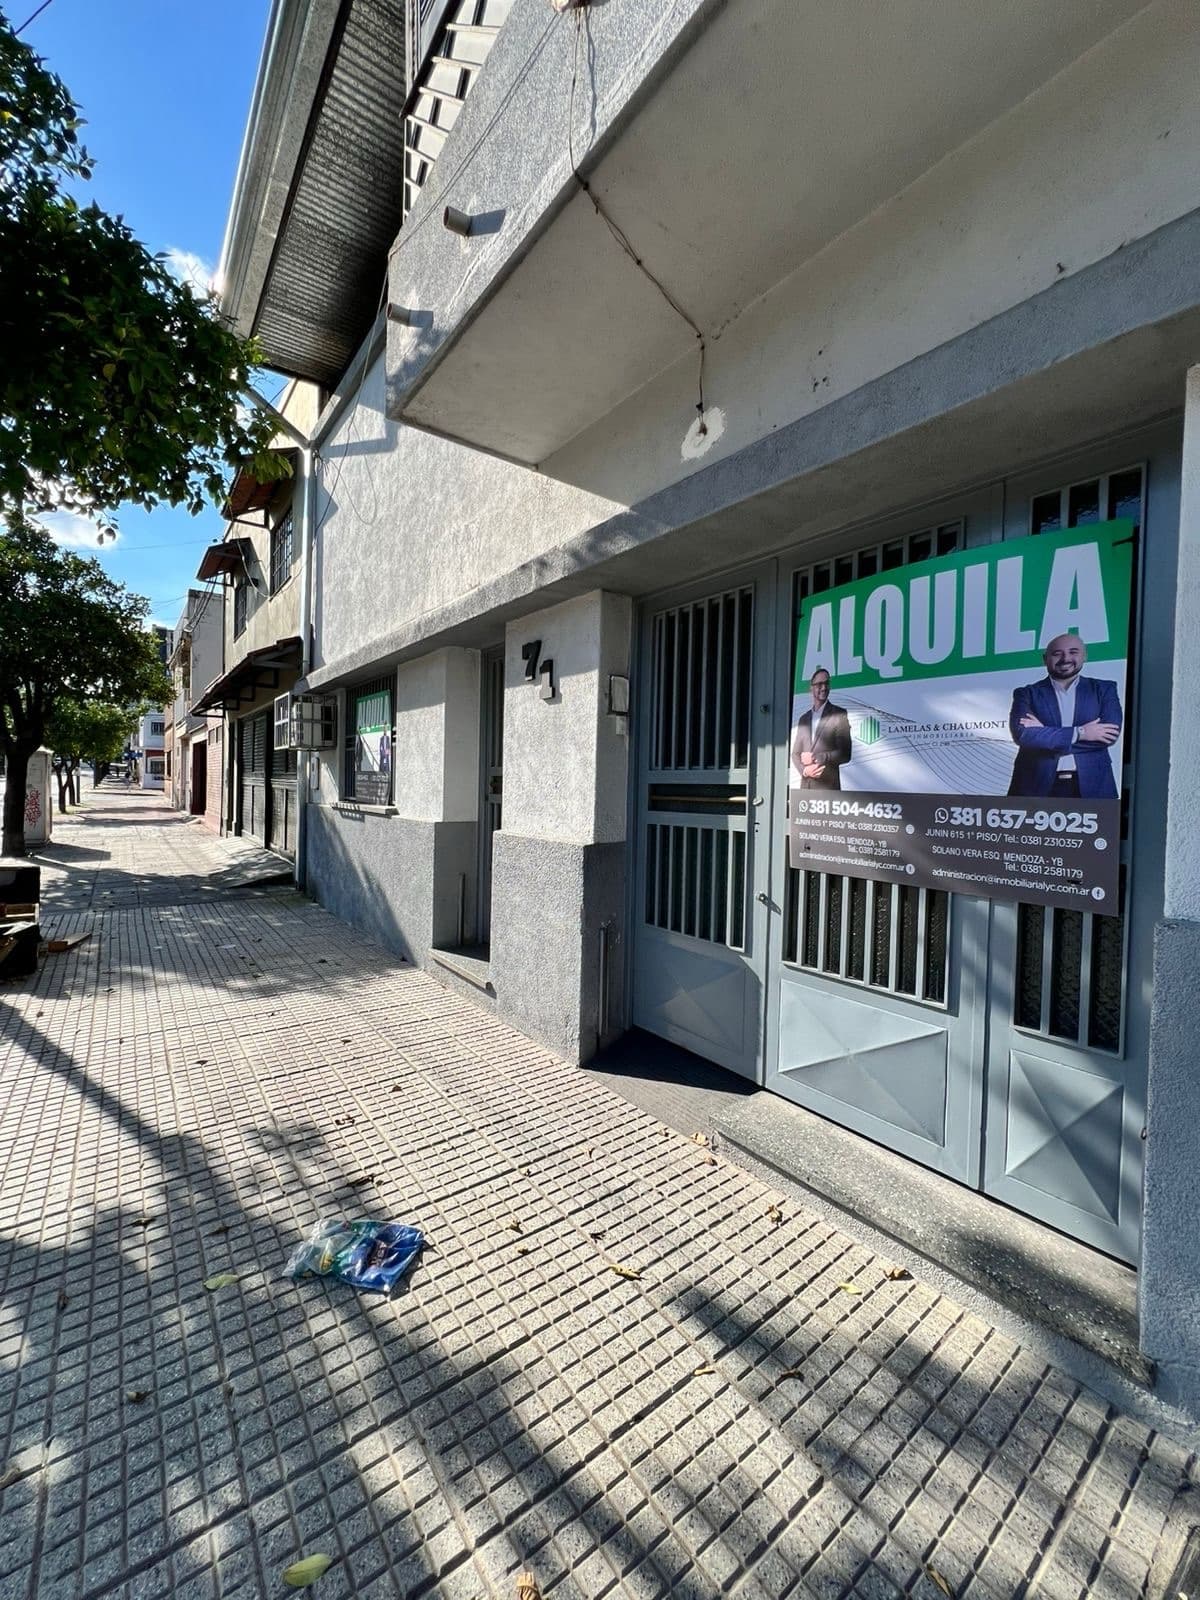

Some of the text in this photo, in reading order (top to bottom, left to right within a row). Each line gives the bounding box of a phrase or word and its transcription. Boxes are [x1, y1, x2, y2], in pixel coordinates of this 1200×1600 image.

[802, 542, 1110, 681] ALQUILA
[888, 720, 1008, 734] LAMELAS & CHAUMONT
[808, 800, 903, 820] 381 504-4632
[950, 807, 1099, 834] 381 637-9025
[950, 830, 965, 840] 615
[1020, 835, 1042, 846] 0381
[1044, 837, 1084, 849] 2310357
[932, 845, 961, 857] SOLANO
[962, 848, 983, 859] VERA
[1003, 853, 1045, 865] MENDOZA
[1051, 857, 1064, 867] YB
[1020, 864, 1042, 875] 0381
[1044, 866, 1084, 880] 2581179
